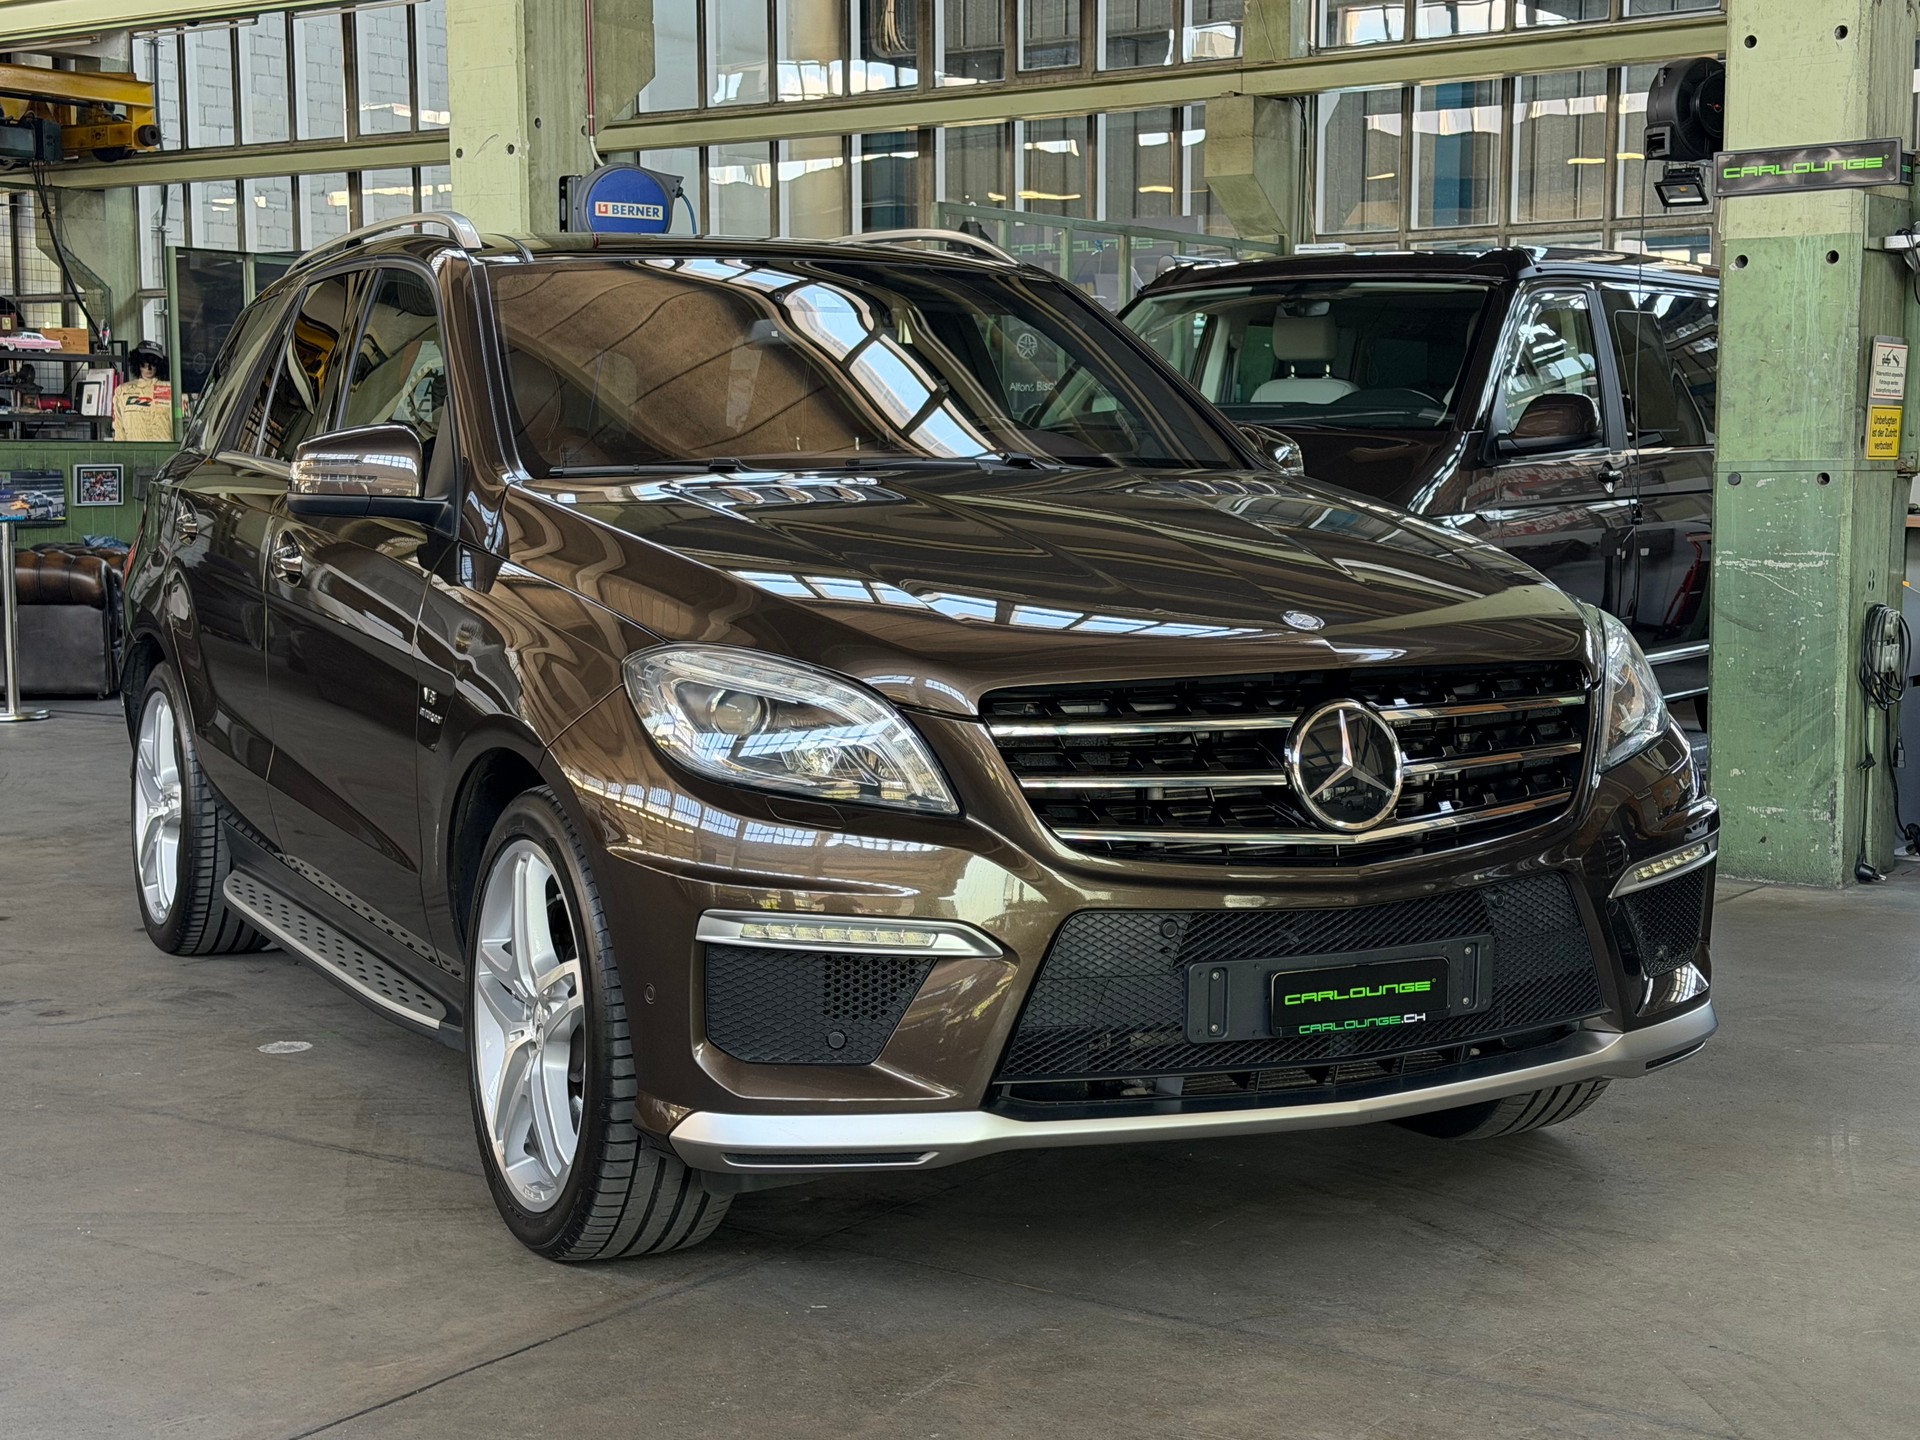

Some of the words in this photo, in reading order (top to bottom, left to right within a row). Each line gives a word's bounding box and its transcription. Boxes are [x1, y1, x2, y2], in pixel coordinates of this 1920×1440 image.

[1723, 156, 1883, 179] CARLOUNGE
[612, 204, 660, 217] BERNER
[1284, 980, 1432, 1006] CARLOUNGE
[1298, 1012, 1427, 1035] CARLOUNGE.CH
